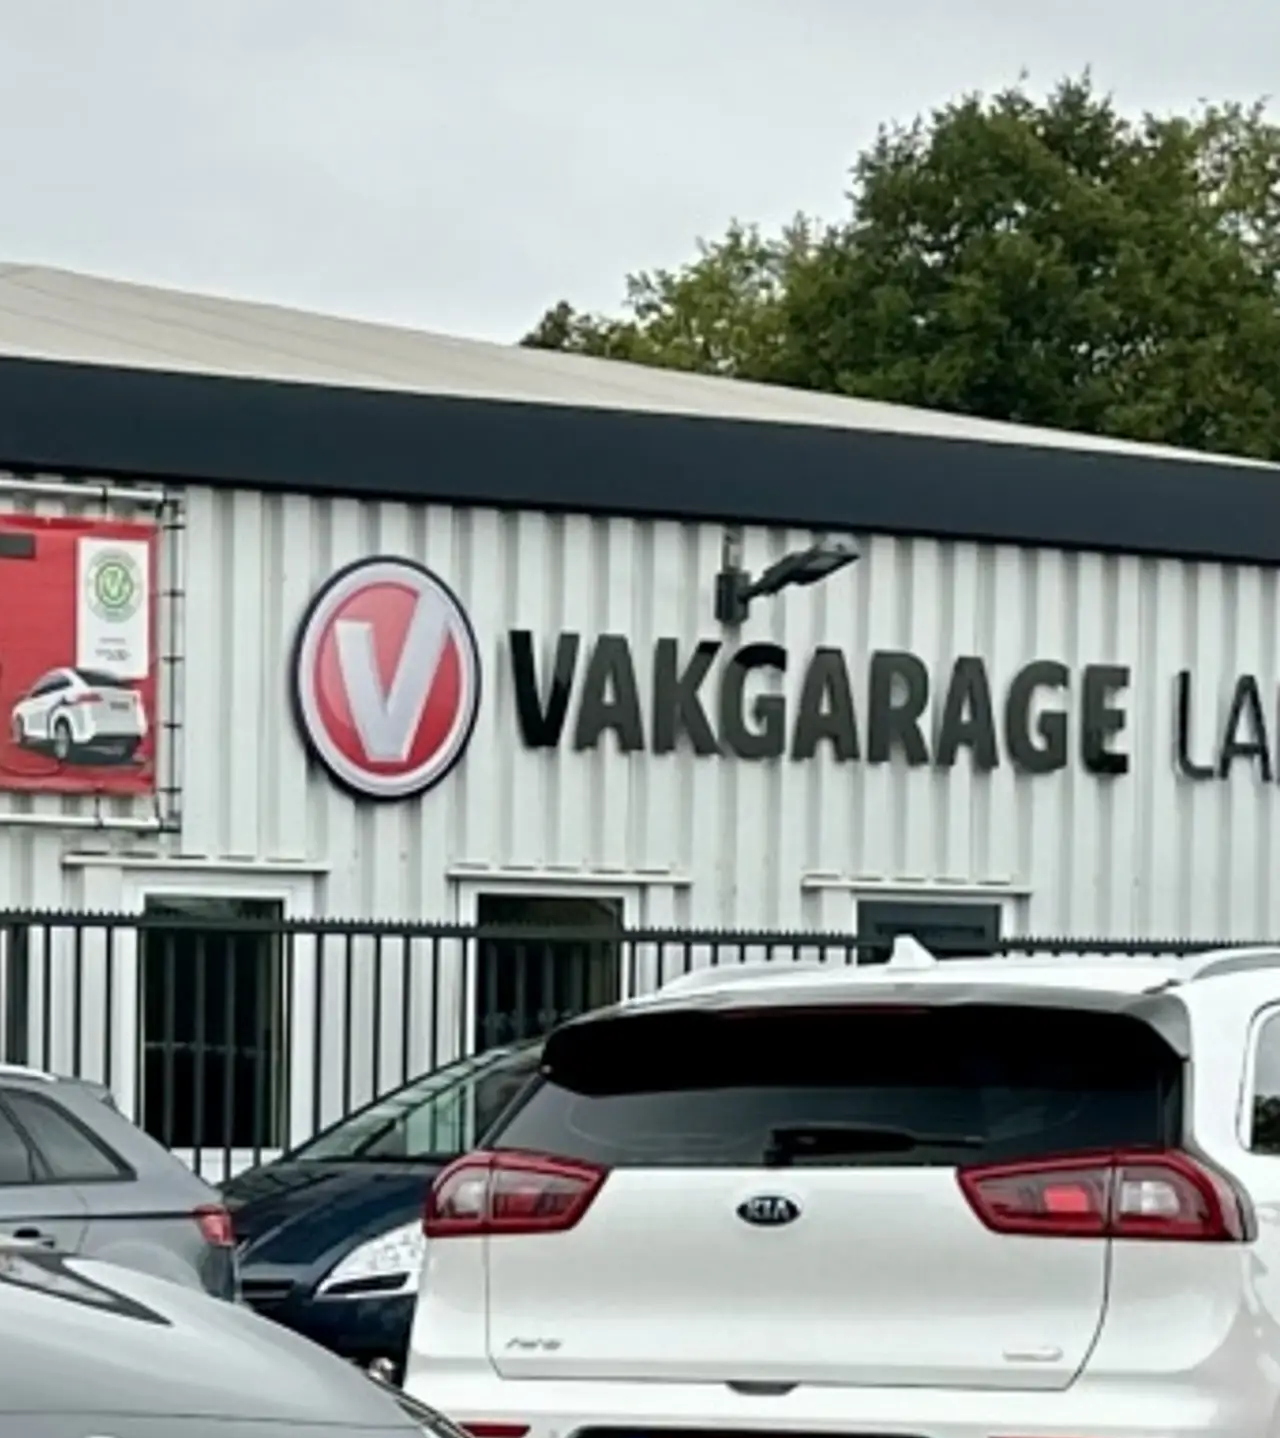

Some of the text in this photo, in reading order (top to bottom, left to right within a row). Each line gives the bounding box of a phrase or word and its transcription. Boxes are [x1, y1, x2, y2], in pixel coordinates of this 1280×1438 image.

[333, 582, 1280, 783] V VAKGARAGE LA
